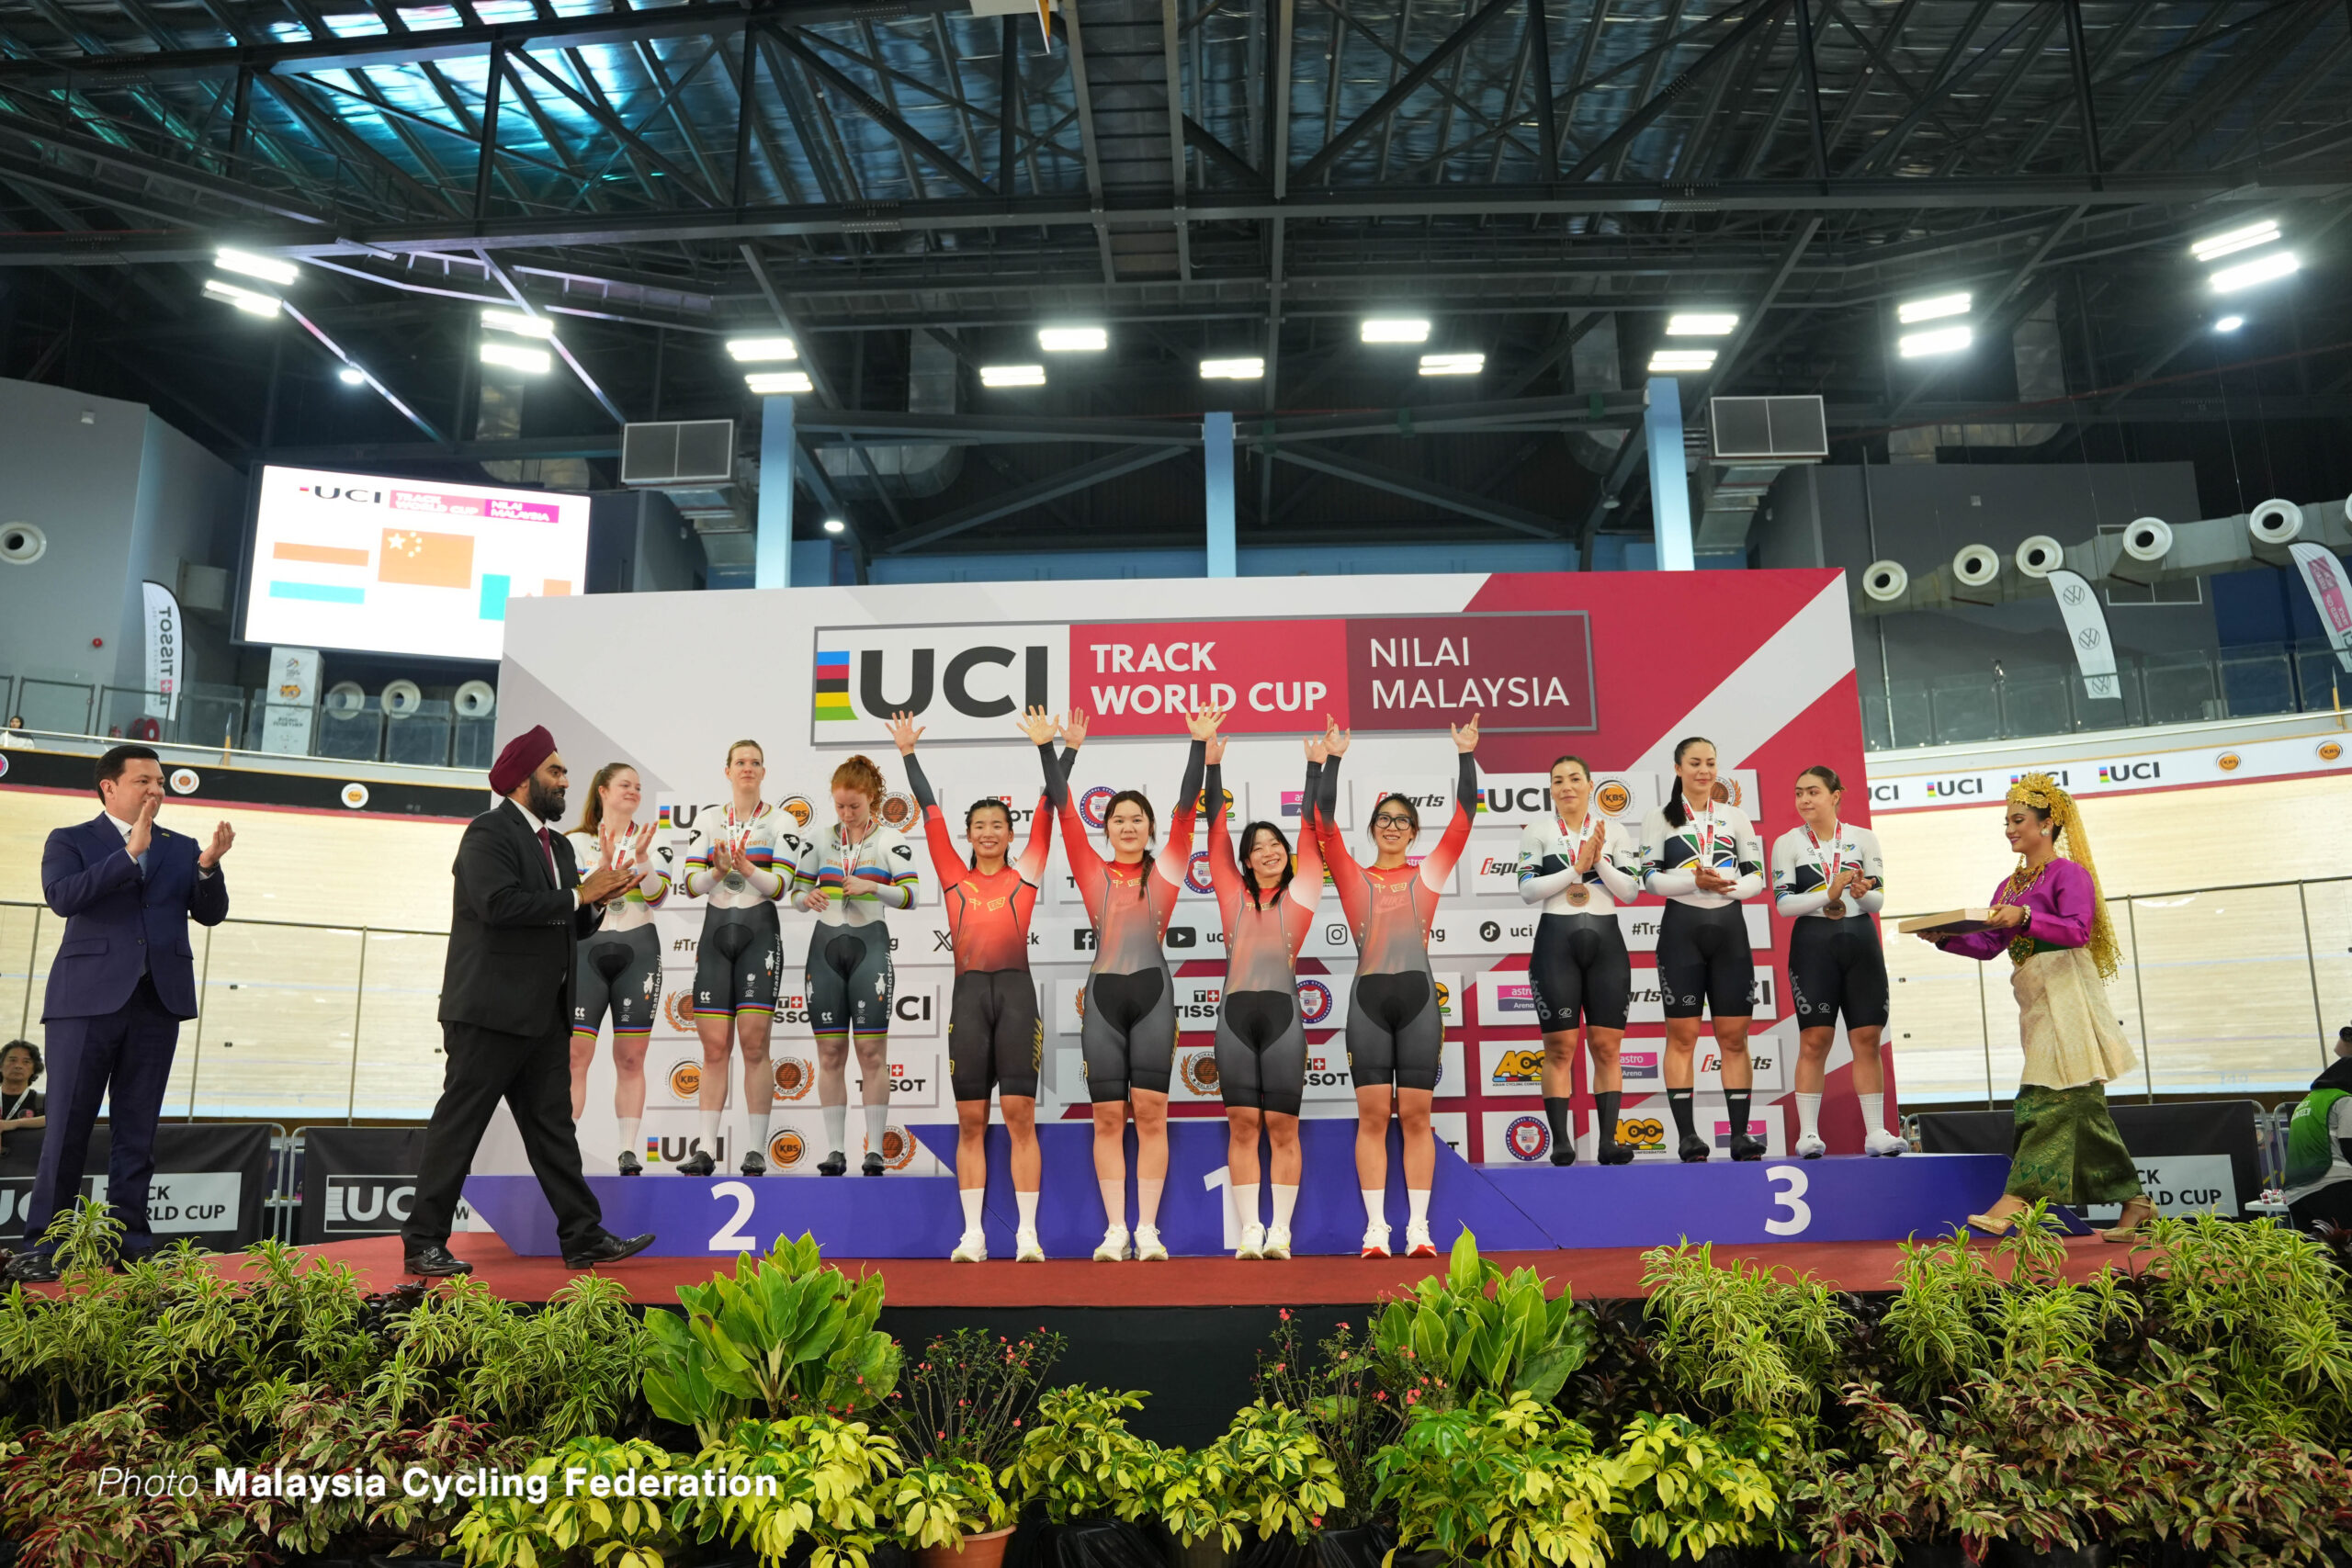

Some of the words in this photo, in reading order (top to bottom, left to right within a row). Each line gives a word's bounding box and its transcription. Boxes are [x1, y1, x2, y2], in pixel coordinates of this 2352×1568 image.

[315, 485, 381, 503] UCI
[396, 492, 441, 504] TRACK
[450, 505, 479, 515] CUP
[491, 508, 550, 522] MALAYSIA
[1091, 641, 1216, 673] TRACK
[1370, 636, 1470, 669] NILAI
[860, 645, 1048, 720] UCI
[1091, 682, 1237, 716] WORLD
[1249, 680, 1328, 713] CUP
[1371, 675, 1570, 711] MALAYSIA
[2110, 761, 2161, 781] UCI
[1936, 778, 1983, 797] UCI
[1487, 787, 1552, 813] UCI
[1605, 793, 1625, 804] KBS
[895, 995, 931, 1021] CI
[1174, 1005, 1216, 1018] TISS
[1032, 1017, 1044, 1073] CHINA
[1620, 1055, 1644, 1064] astro
[680, 1076, 699, 1084] KBS
[855, 1079, 926, 1092] TSOT
[779, 1145, 798, 1154] KBS
[346, 1186, 416, 1222] UC
[1764, 1165, 1812, 1236] 3
[2179, 1189, 2222, 1205] CUP
[185, 1204, 226, 1220] CUP
[708, 1180, 756, 1251] 2
[1203, 1165, 1243, 1250] 1
